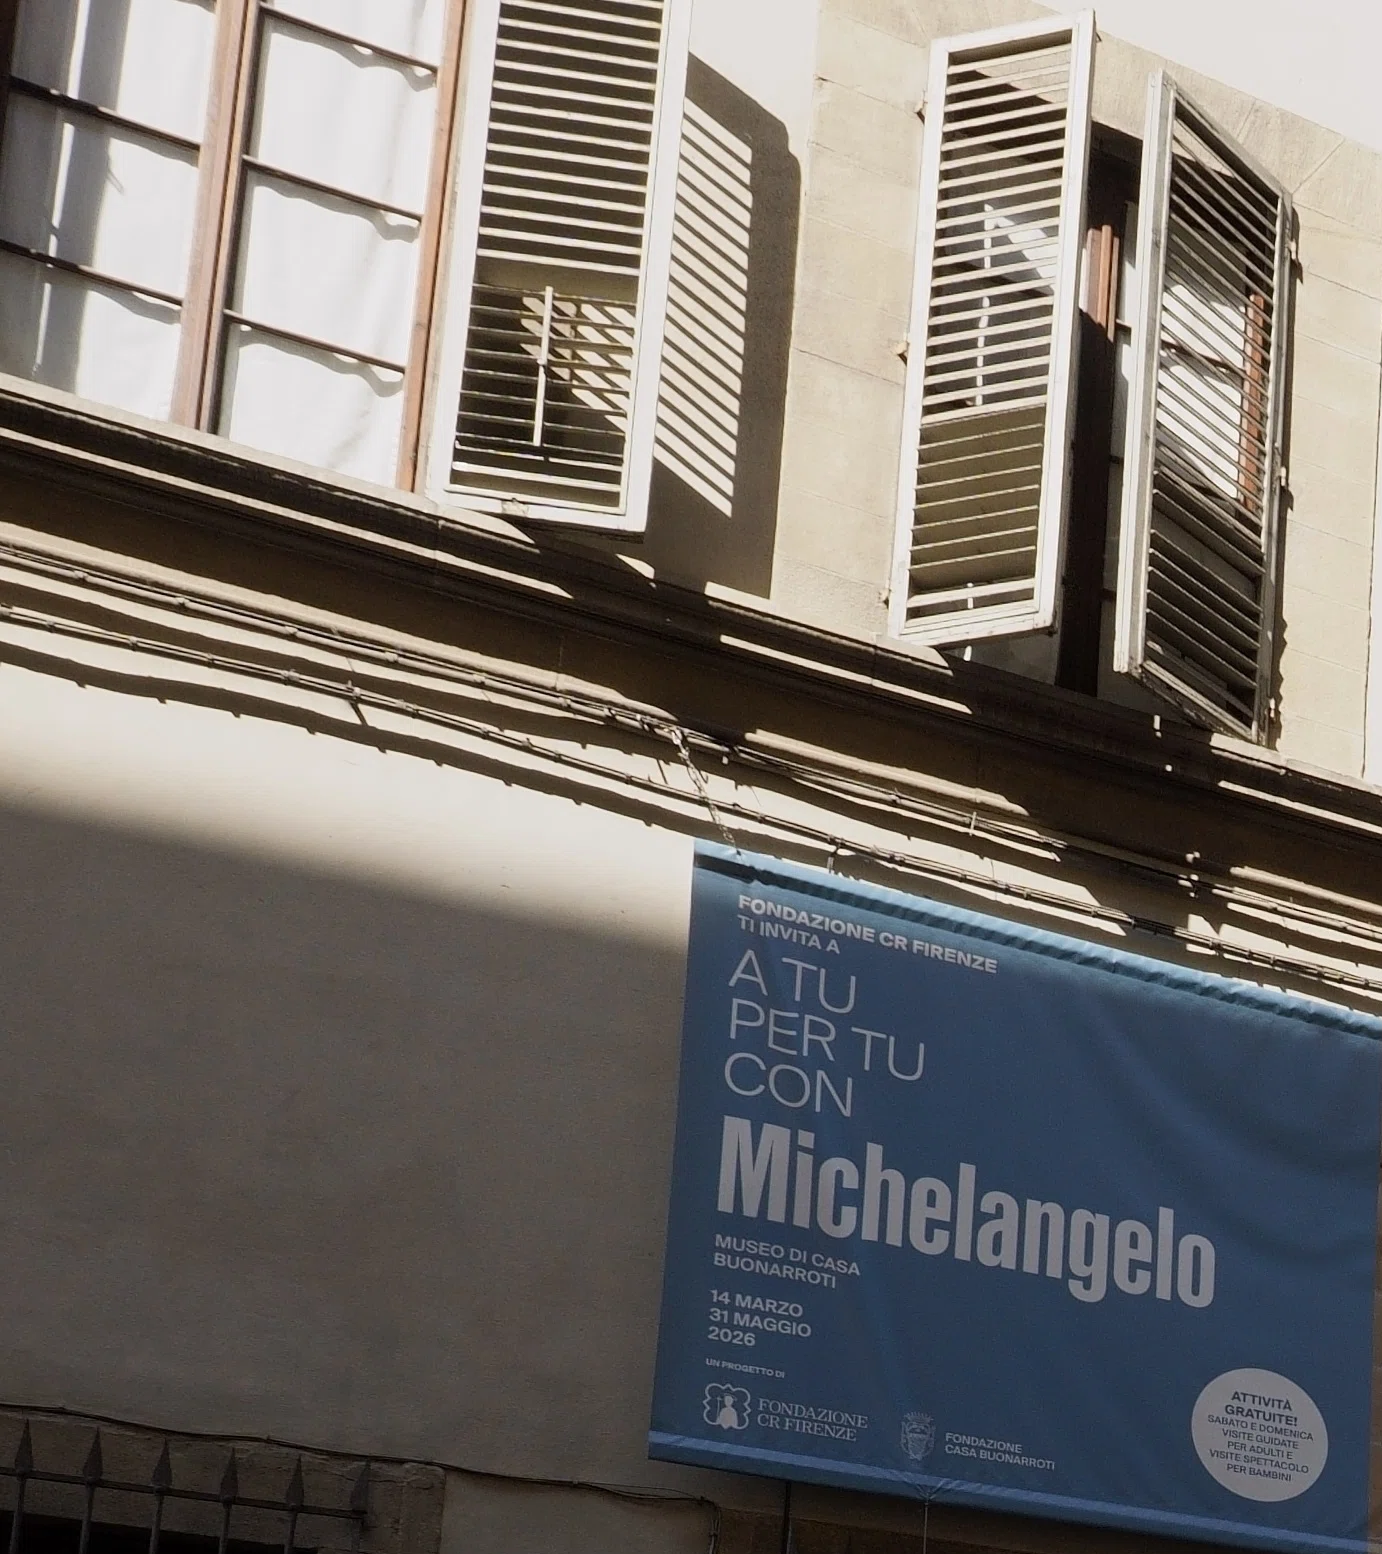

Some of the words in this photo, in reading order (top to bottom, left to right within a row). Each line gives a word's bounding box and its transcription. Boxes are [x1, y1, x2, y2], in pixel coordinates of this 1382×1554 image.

[738, 914, 755, 933] TI
[760, 919, 821, 950] INVITA
[826, 939, 840, 954] A
[738, 895, 875, 943] FONDAZIONE
[879, 931, 908, 951] CR
[912, 940, 998, 974] FIRENZE
[728, 949, 768, 996] A
[782, 957, 856, 1014] TU
[730, 998, 836, 1061] PER
[851, 1027, 925, 1081] TU
[724, 1053, 853, 1117] CON
[717, 1115, 1216, 1308] Michelangelo
[715, 1233, 785, 1259] MUSEO
[789, 1248, 807, 1263] DI
[811, 1253, 860, 1276] CASA
[713, 1252, 836, 1289] BUONARROTI
[710, 1289, 731, 1305] 14
[735, 1294, 803, 1317] MARZO
[707, 1326, 756, 1346] 2026
[709, 1307, 728, 1323] 31
[733, 1312, 812, 1337] MAGGIO
[705, 1358, 720, 1367] UN
[721, 1361, 774, 1377] PROGETTO
[775, 1370, 785, 1378] DI
[758, 1398, 868, 1429] FONDAZIONE
[1231, 1391, 1292, 1411] ATTIVITÀ
[757, 1413, 780, 1429] CR
[783, 1417, 857, 1442] FIRENZE
[1207, 1414, 1248, 1429] SABATO
[1250, 1422, 1257, 1431] E
[1259, 1424, 1314, 1441] DOMENICA
[1225, 1404, 1298, 1427] GRATUITE!
[945, 1432, 1023, 1454] FONDAZIONE
[1222, 1428, 1253, 1442] VISITE
[1256, 1435, 1299, 1450] GUIDATE
[1228, 1441, 1247, 1452] PER
[1249, 1445, 1284, 1458] ADULTI
[1287, 1451, 1293, 1459] E
[945, 1444, 977, 1458] CASA
[979, 1449, 1055, 1471] BUONARROTI
[1209, 1449, 1240, 1462] VISITE
[1243, 1454, 1309, 1474] SPETTACOLO
[1227, 1463, 1246, 1475] PER
[1249, 1467, 1292, 1482] BAMBINI
